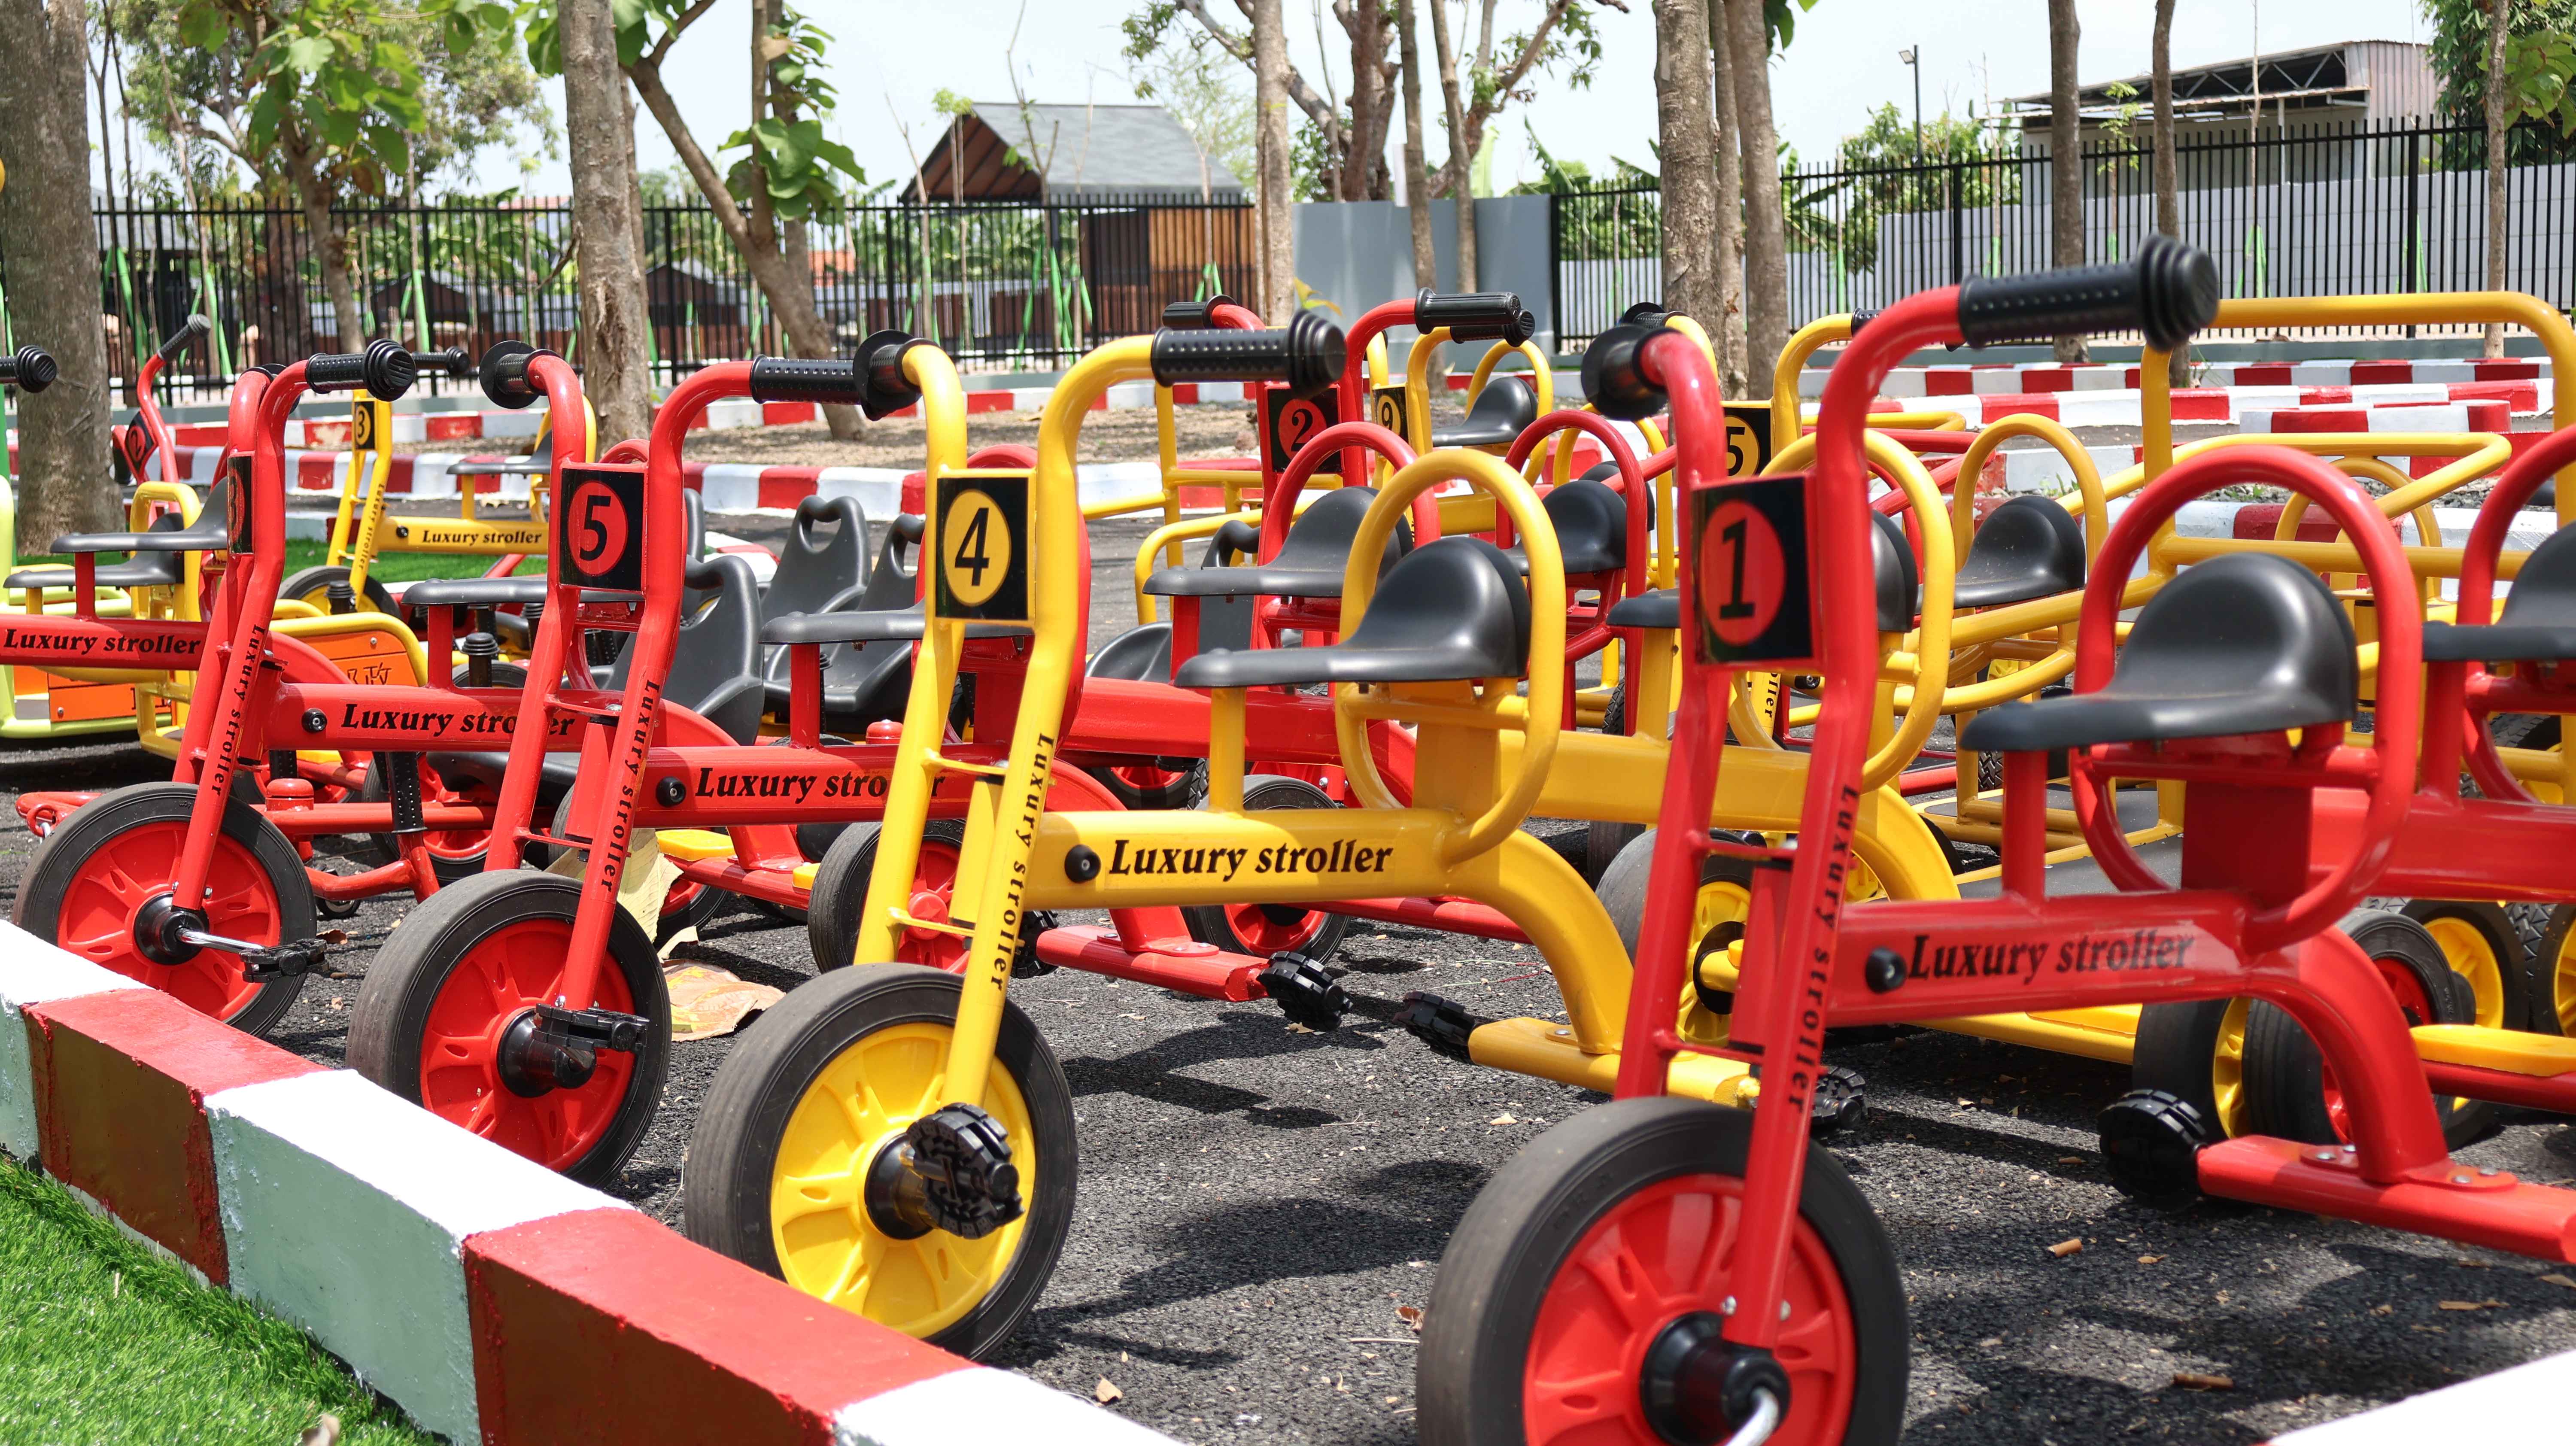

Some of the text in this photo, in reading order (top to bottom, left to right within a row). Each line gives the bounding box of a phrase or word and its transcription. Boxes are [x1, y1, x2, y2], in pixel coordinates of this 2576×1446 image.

[356, 409, 364, 438] 3
[1291, 409, 1313, 451] 2
[1382, 402, 1393, 430] 9
[131, 431, 141, 460] 2
[1726, 427, 1746, 476] 5
[359, 483, 385, 570] Luxury stroller
[422, 530, 542, 546] Luxury stroller
[580, 495, 611, 561] 5
[955, 507, 990, 586] 4
[1719, 519, 1756, 620] 1
[4, 629, 201, 655] Luxury stroller
[212, 624, 265, 796] Luxury stroller
[341, 704, 575, 737] Luxury stroer
[601, 680, 659, 893] Luxury stroller
[695, 767, 945, 804] Luxury stror
[990, 732, 1054, 992] Luxury stroller
[1109, 839, 1393, 882] Luxury stroller
[1788, 784, 1859, 1114] Luxury stroller
[1909, 929, 2193, 985] Luxury stroller
